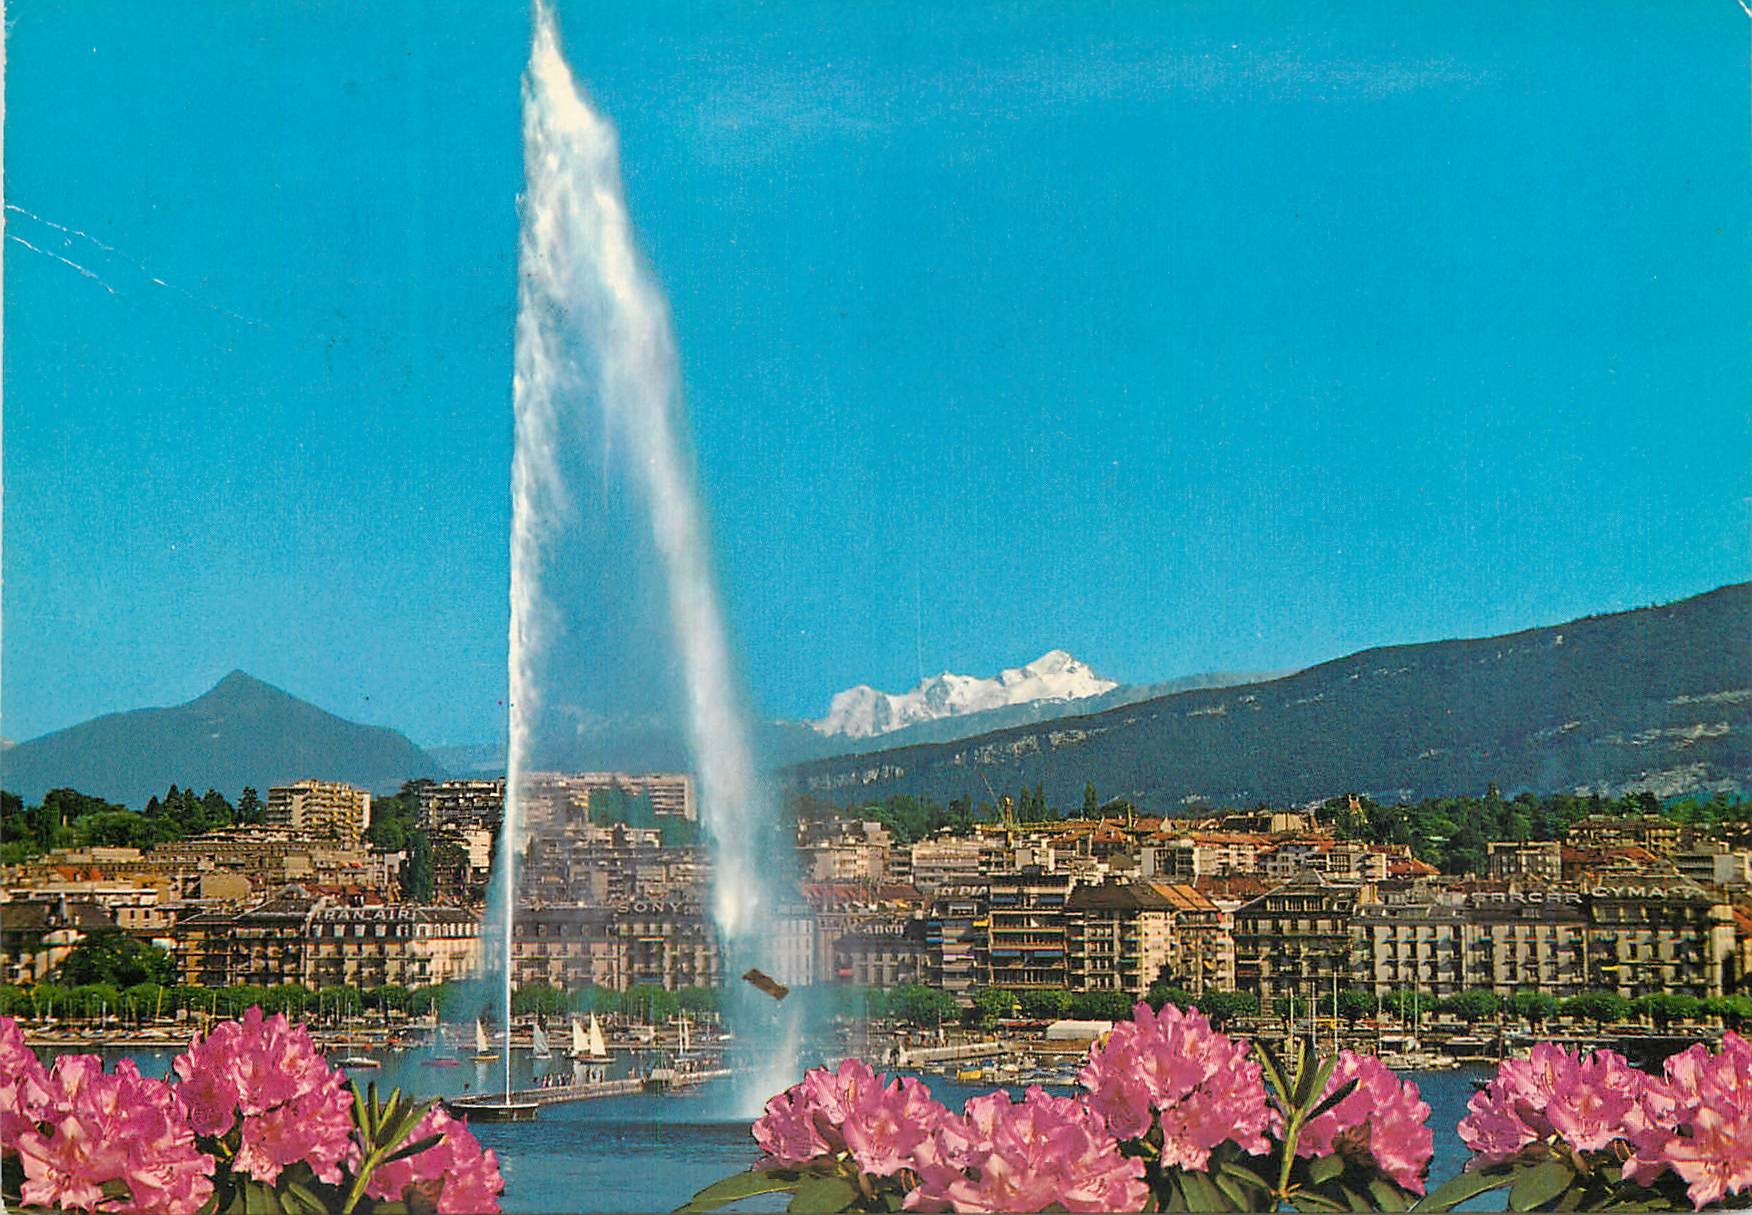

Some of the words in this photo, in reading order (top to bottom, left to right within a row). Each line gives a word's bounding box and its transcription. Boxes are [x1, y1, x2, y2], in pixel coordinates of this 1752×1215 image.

[1591, 886, 1664, 898] CYMA
[617, 900, 684, 913] SONY
[316, 909, 364, 925] IRAN
[373, 909, 408, 925] AIR
